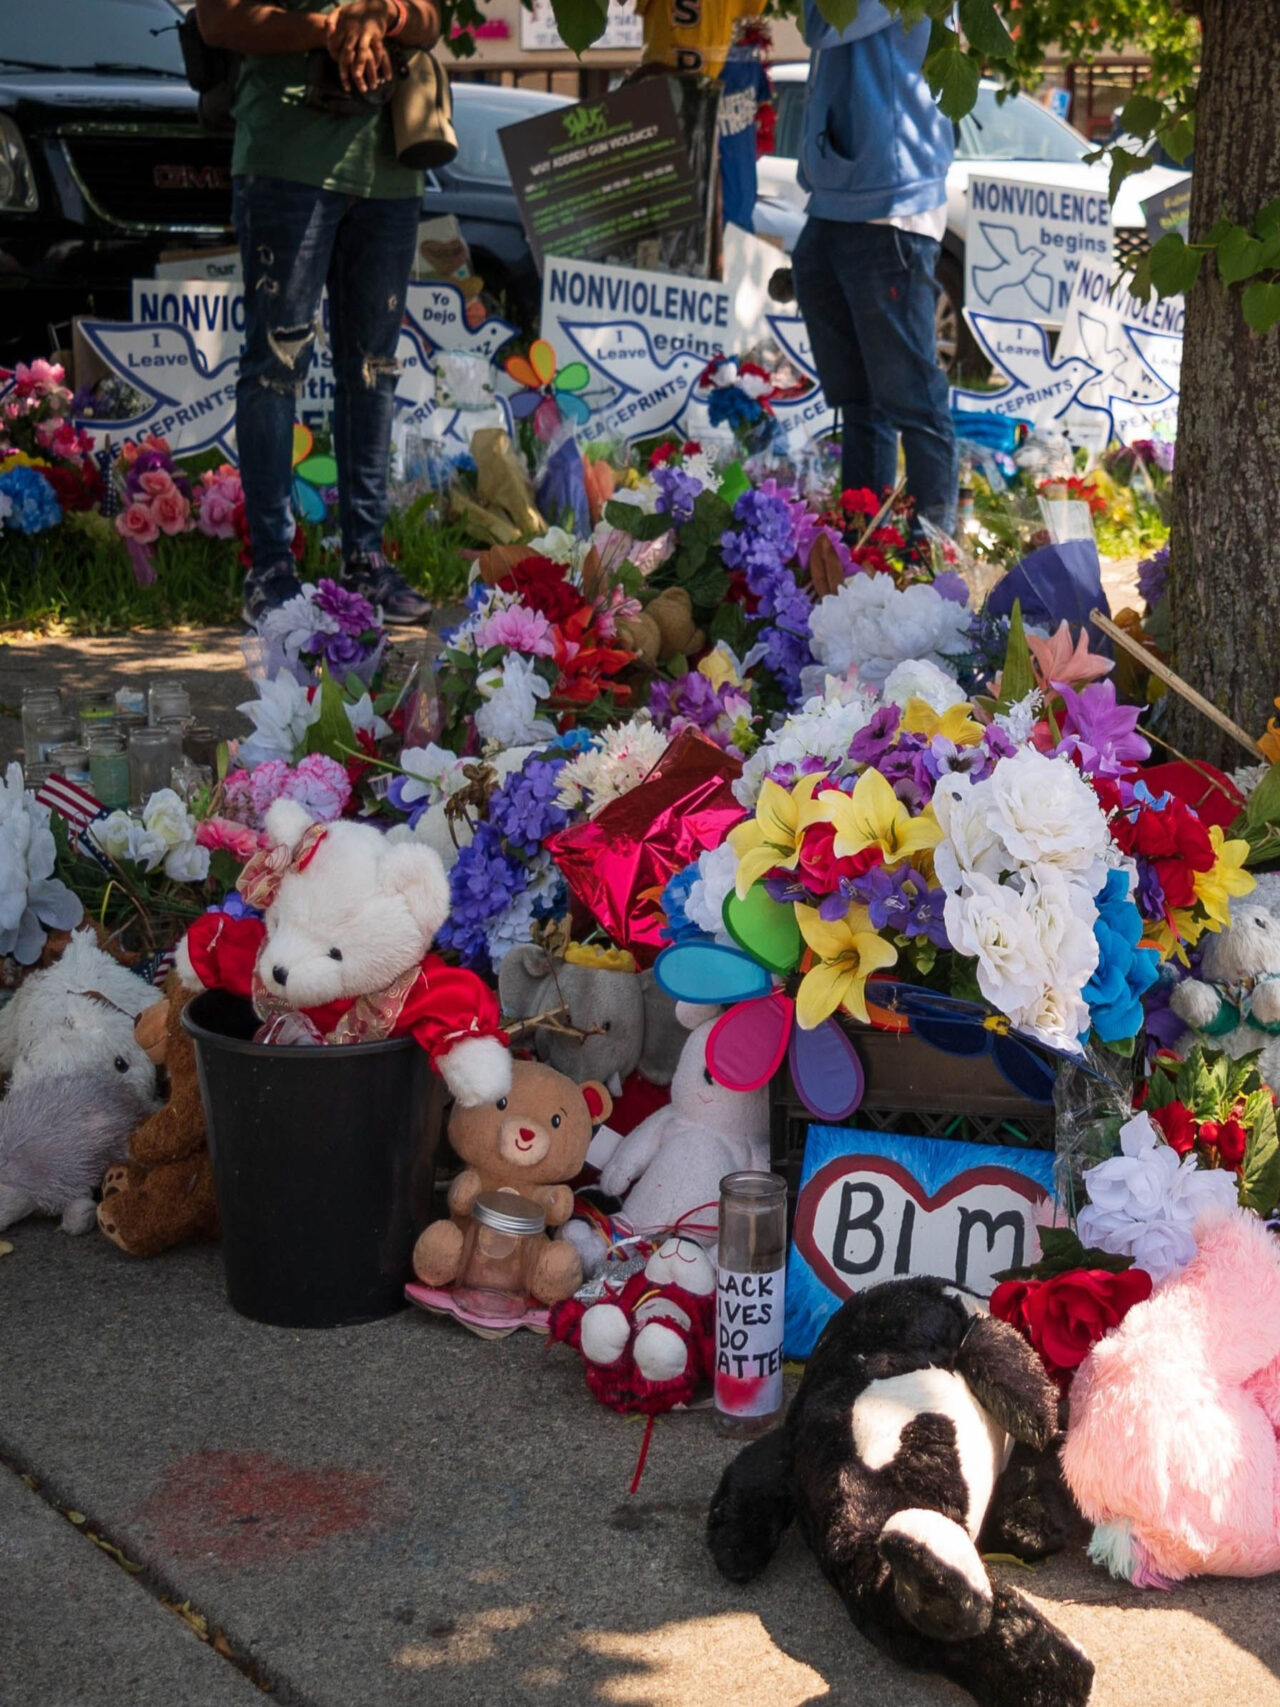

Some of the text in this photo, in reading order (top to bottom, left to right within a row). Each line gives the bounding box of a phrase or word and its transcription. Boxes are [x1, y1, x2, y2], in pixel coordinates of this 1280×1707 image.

[972, 181, 1109, 226] NONVIOLENCE
[1040, 228, 1107, 253] begins
[432, 292, 449, 305] Yo
[550, 268, 730, 327] NONVIOLENCE
[423, 308, 456, 324] Dejo
[152, 333, 161, 347] I
[616, 330, 623, 343] I
[1016, 328, 1023, 340] I
[597, 348, 646, 361] Leave
[997, 342, 1040, 357] Leave
[128, 353, 188, 368] Leave
[986, 379, 1073, 416] CEPRINTS
[576, 375, 688, 442] EACEPRINTS
[719, 1323, 749, 1351] DO
